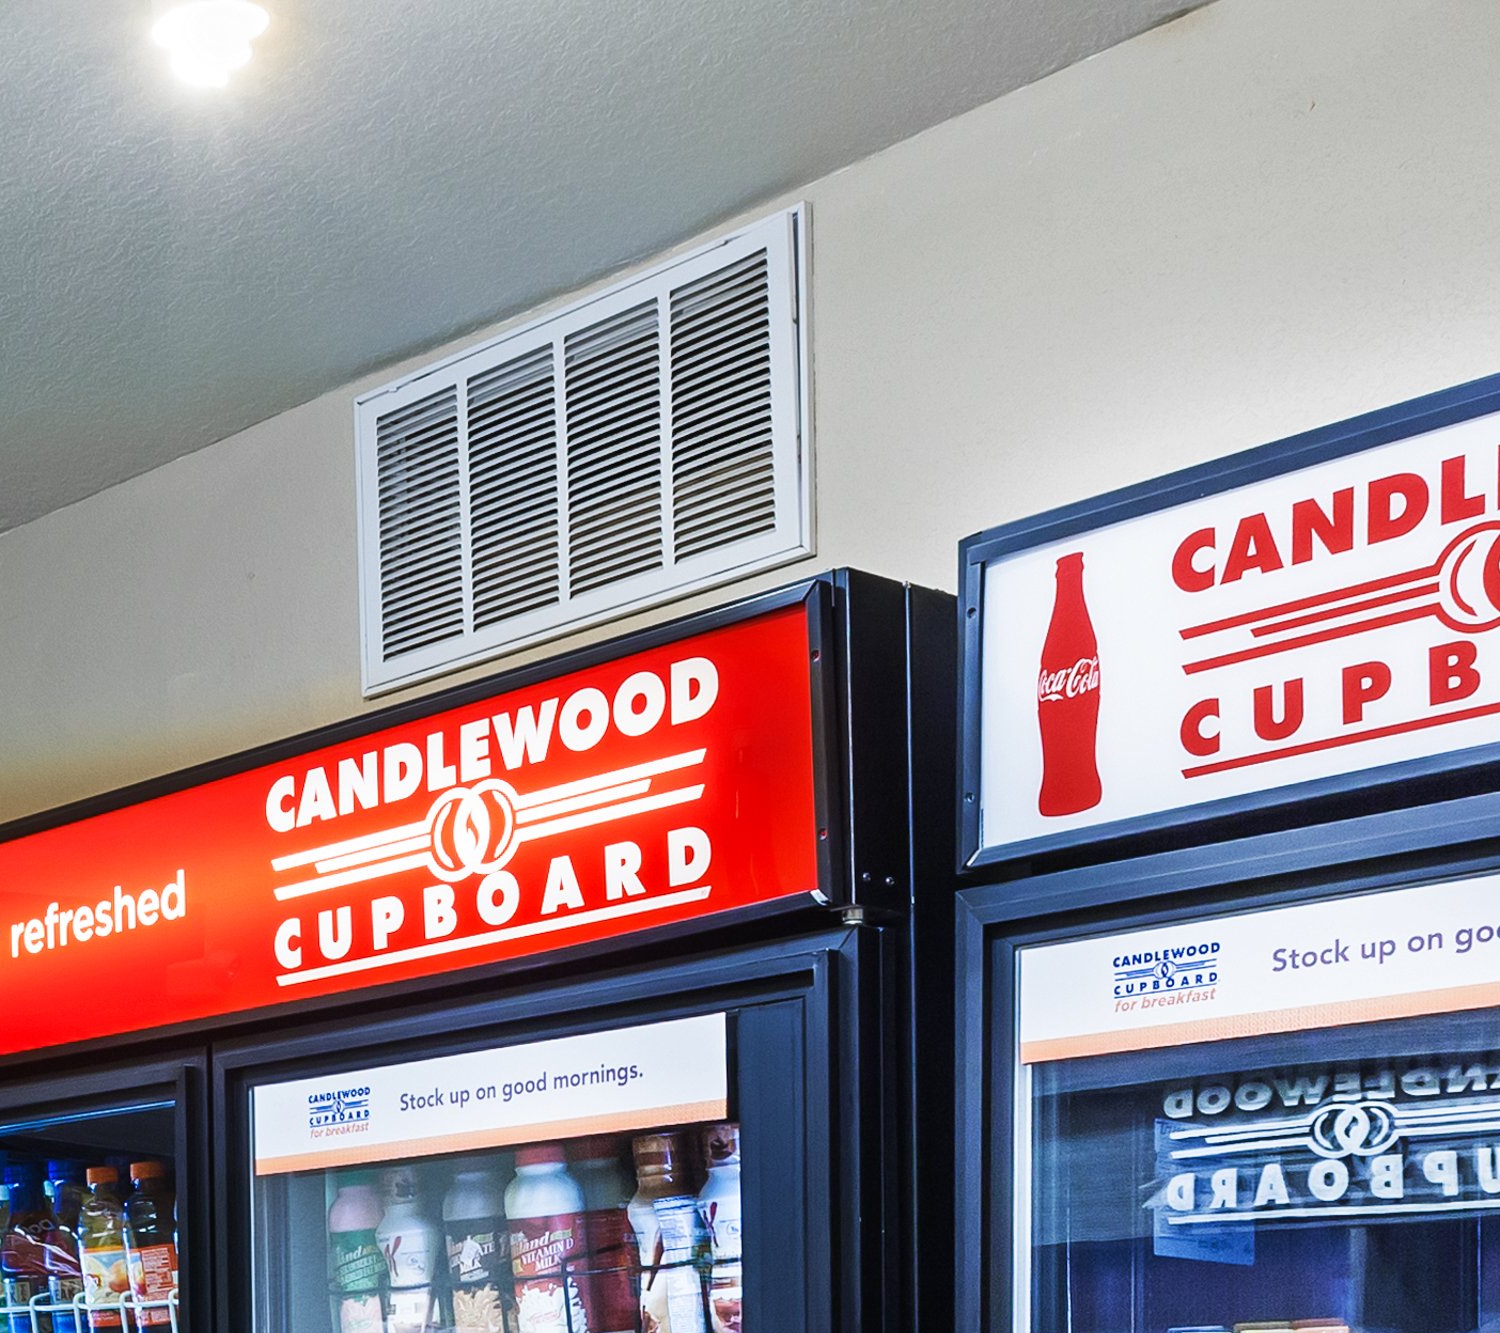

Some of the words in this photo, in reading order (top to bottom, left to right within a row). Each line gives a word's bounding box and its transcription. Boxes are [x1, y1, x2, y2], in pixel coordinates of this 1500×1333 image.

[1037, 651, 1101, 703] Coca-Cola
[265, 654, 720, 836] CANDLEWOOD
[10, 867, 187, 960] refreshed
[272, 824, 713, 969] CUPBOARD
[1112, 942, 1221, 968] CANDLEWOOD
[1271, 941, 1350, 973] Stock
[1358, 938, 1396, 966] up
[1407, 928, 1443, 953] on
[1113, 971, 1219, 998] CUPBOARD
[1114, 995, 1137, 1014] for
[1140, 986, 1217, 1009] breakfast
[308, 1086, 371, 1104] CANDLEWOOD
[399, 1089, 444, 1112] Stock
[449, 1088, 471, 1109] up
[475, 1084, 498, 1101] on
[502, 1071, 548, 1102] good
[552, 1061, 644, 1090] mornings.
[308, 1109, 371, 1126] CUPBOARD
[309, 1127, 323, 1139] for
[325, 1121, 370, 1137] breakfast
